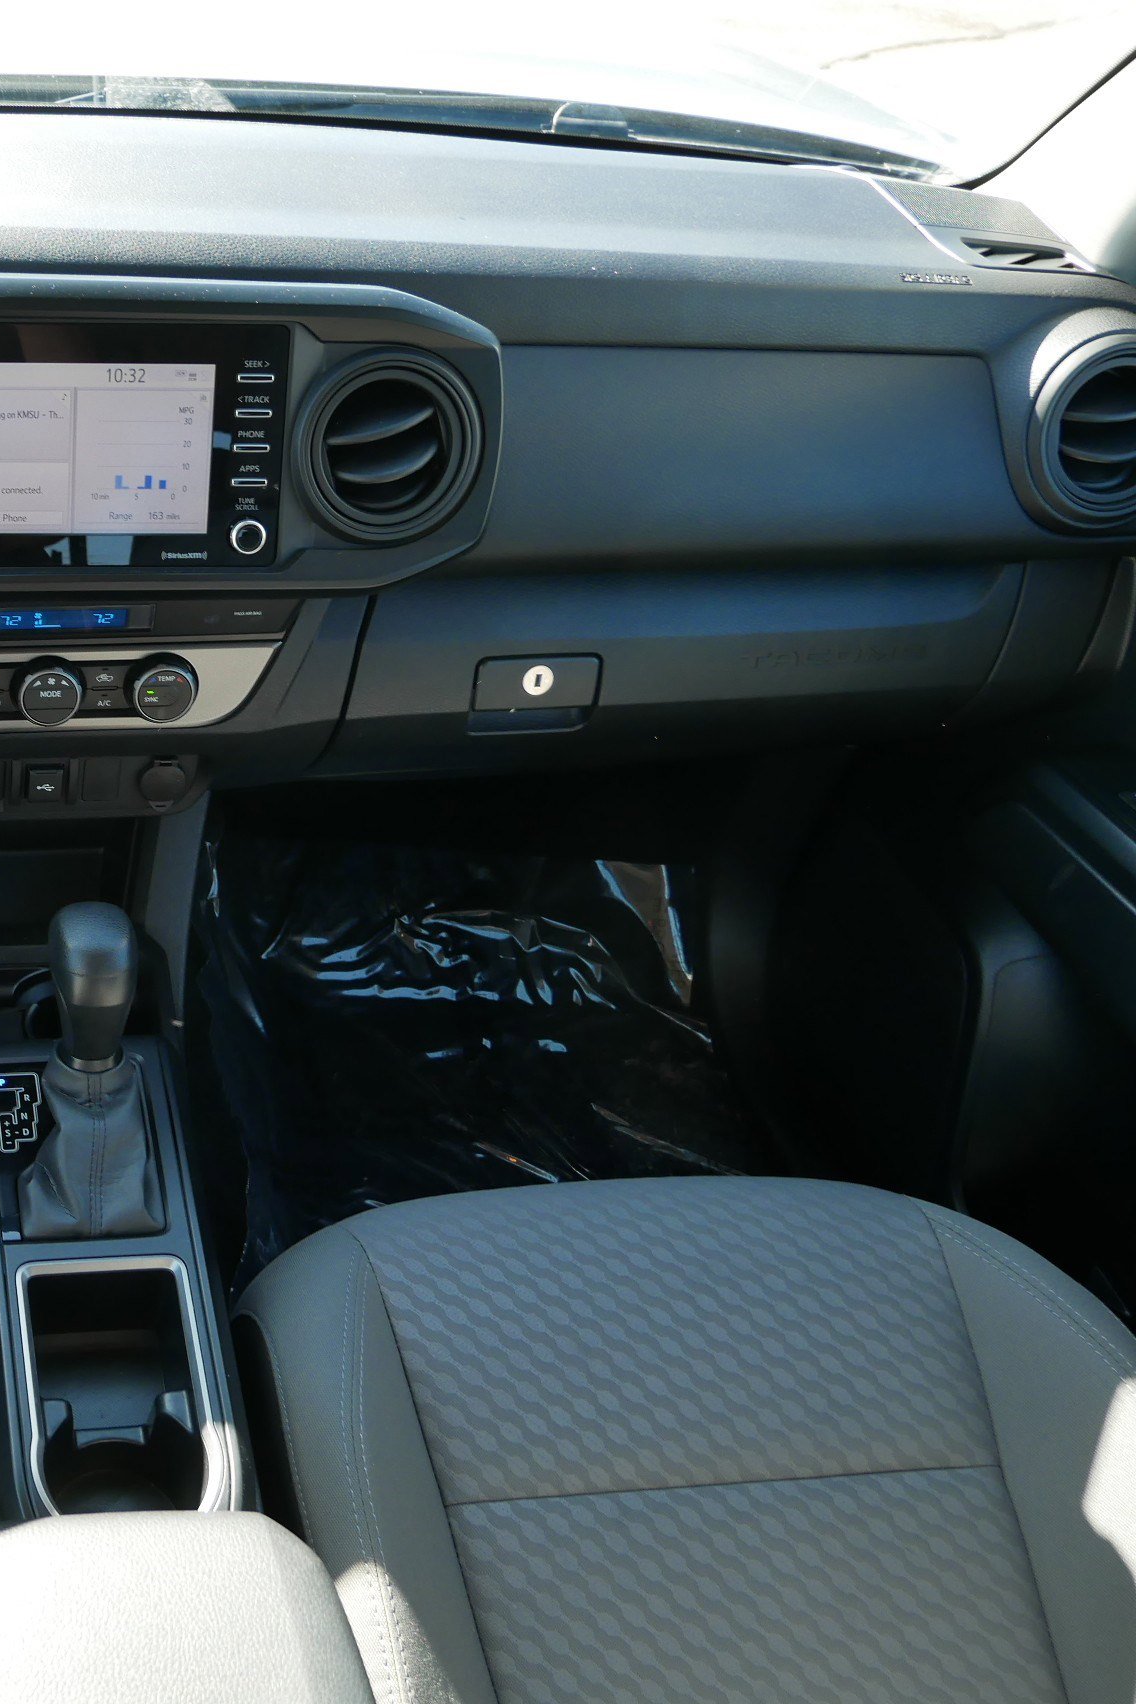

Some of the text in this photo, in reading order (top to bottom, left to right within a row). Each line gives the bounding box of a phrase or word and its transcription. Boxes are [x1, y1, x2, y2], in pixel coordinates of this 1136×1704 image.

[244, 360, 263, 368] SEEK
[106, 368, 146, 383] 10:32
[178, 406, 194, 414] MPG
[17, 410, 40, 419] KMSU
[237, 430, 265, 438] PHONE
[1, 486, 42, 494] connected.
[2, 514, 27, 522] Phone
[109, 511, 133, 521] Range
[148, 512, 163, 520] 163
[0, 615, 22, 626] 72
[93, 613, 115, 624] 72
[24, 1094, 30, 1102] R
[21, 1112, 28, 1120] N
[5, 1129, 11, 1137] S
